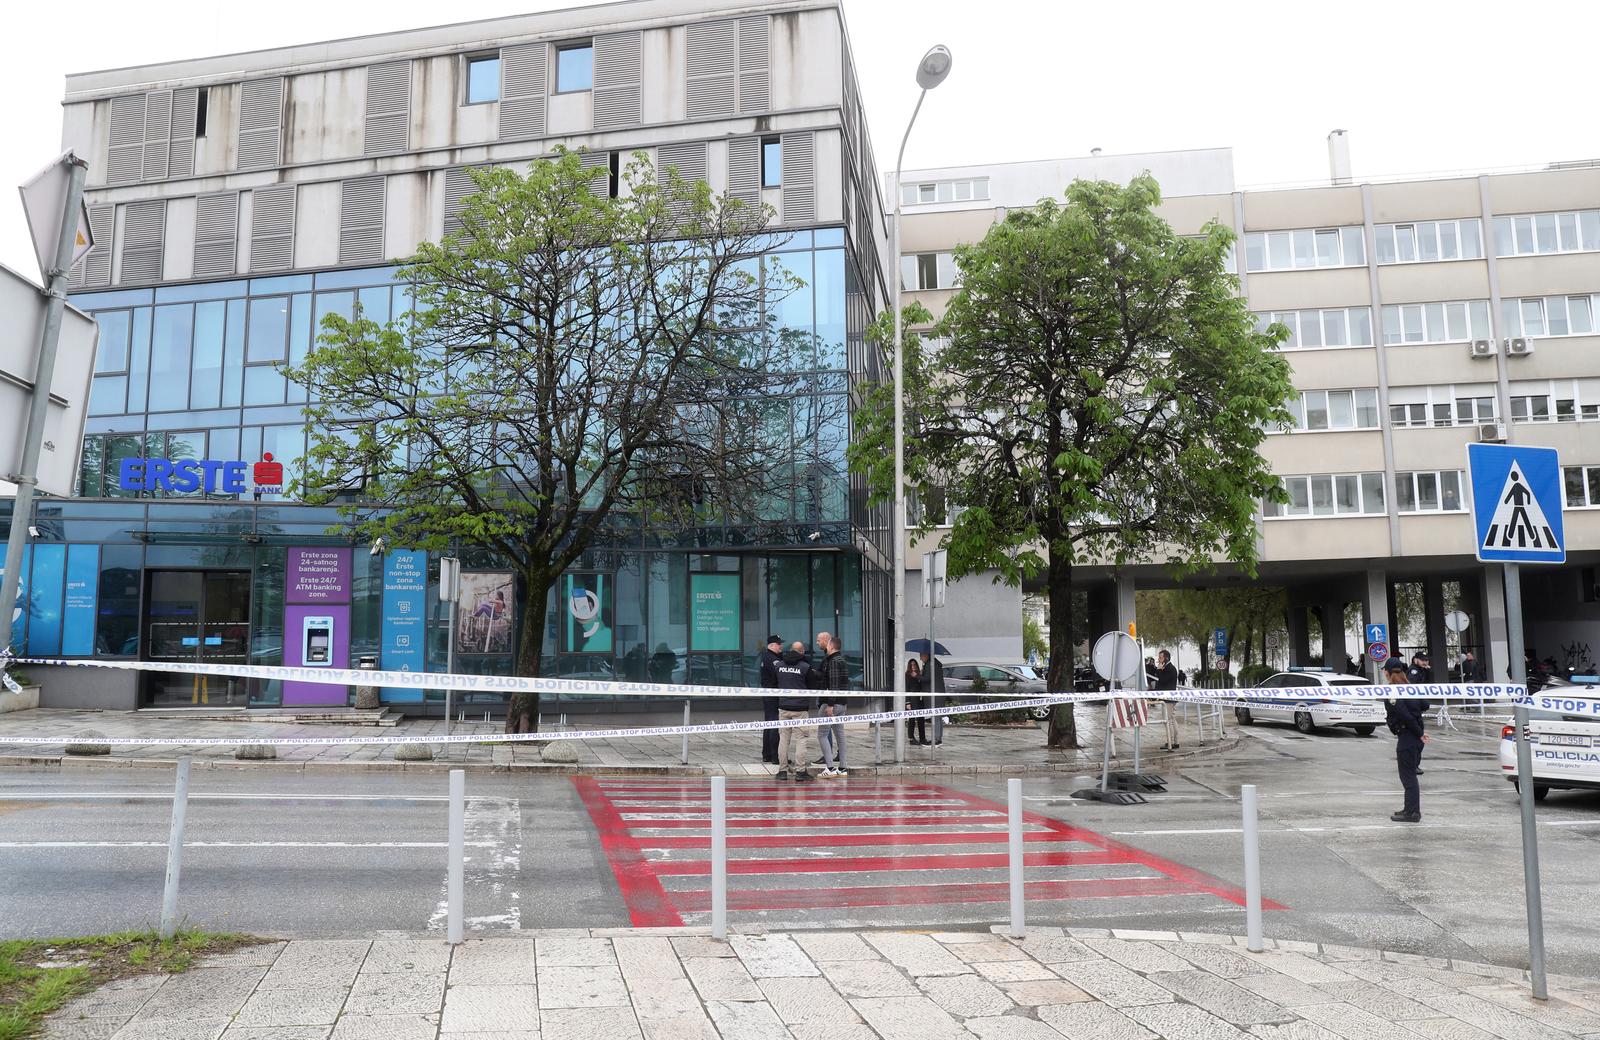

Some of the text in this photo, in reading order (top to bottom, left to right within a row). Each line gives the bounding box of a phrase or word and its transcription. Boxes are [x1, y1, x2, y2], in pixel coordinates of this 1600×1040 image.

[120, 457, 248, 493] ERSTE
[313, 584, 341, 592] banking
[385, 584, 424, 592] bankarenja
[779, 667, 801, 675] POLICIJA
[1242, 689, 1281, 697] STOP
[1285, 687, 1352, 697] POLICIJA
[1356, 686, 1393, 697] STOP
[1398, 685, 1462, 696] POLICIJA
[1466, 686, 1501, 697] STOP
[1542, 698, 1586, 711] STOP
[696, 724, 728, 732] POLICIJA
[750, 721, 781, 729] POLICIJA
[854, 713, 884, 721] POLICIJA
[904, 709, 933, 717] POLICIJA
[953, 705, 981, 713] POLICIJA
[1535, 750, 1600, 762] POLICIJA
